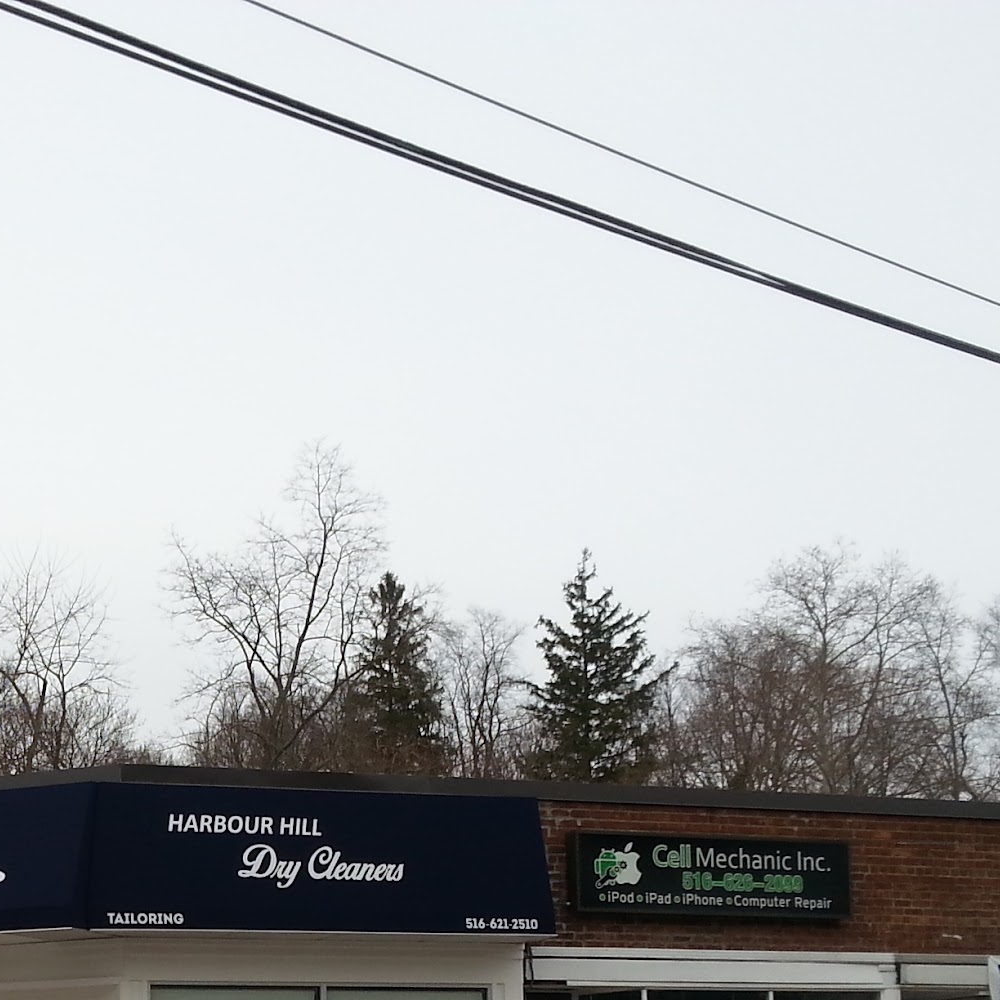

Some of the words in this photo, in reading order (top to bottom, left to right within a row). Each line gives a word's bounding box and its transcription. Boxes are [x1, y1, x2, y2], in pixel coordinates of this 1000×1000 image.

[167, 813, 273, 835] HARBOUR
[279, 817, 322, 837] HILL
[237, 843, 301, 888] Dry
[307, 846, 404, 882] Cleaners
[652, 844, 691, 868] Cell
[696, 847, 794, 871] Mechanic
[797, 851, 831, 872] Inc.
[607, 891, 634, 904] iPod
[645, 892, 671, 905] iPad
[682, 893, 723, 906] iPhone
[734, 894, 791, 909] Computer
[795, 897, 832, 911] Repair
[107, 912, 184, 925] TAILORING
[465, 917, 538, 930] 516-621-2510
